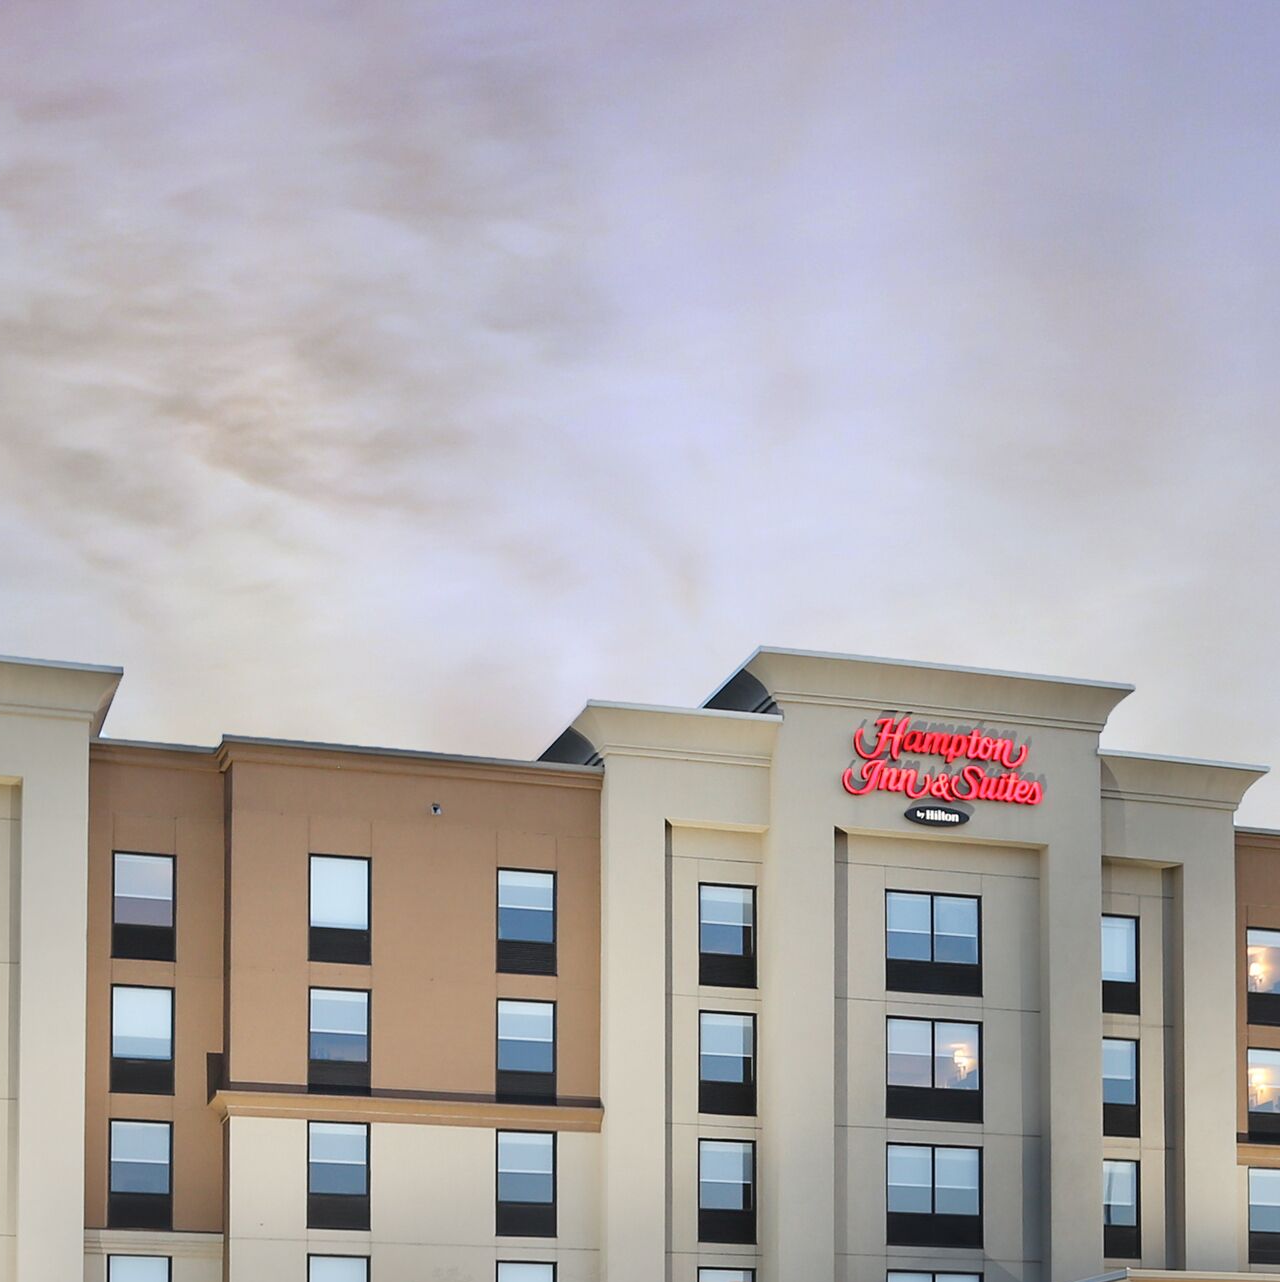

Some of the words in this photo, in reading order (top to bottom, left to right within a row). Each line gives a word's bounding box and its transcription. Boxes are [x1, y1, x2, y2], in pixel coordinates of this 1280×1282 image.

[854, 717, 1028, 768] Hampton
[843, 760, 930, 799] Inn
[931, 774, 955, 801] &
[951, 765, 1042, 805] Suites
[916, 810, 925, 819] by
[926, 810, 959, 822] Hilton
